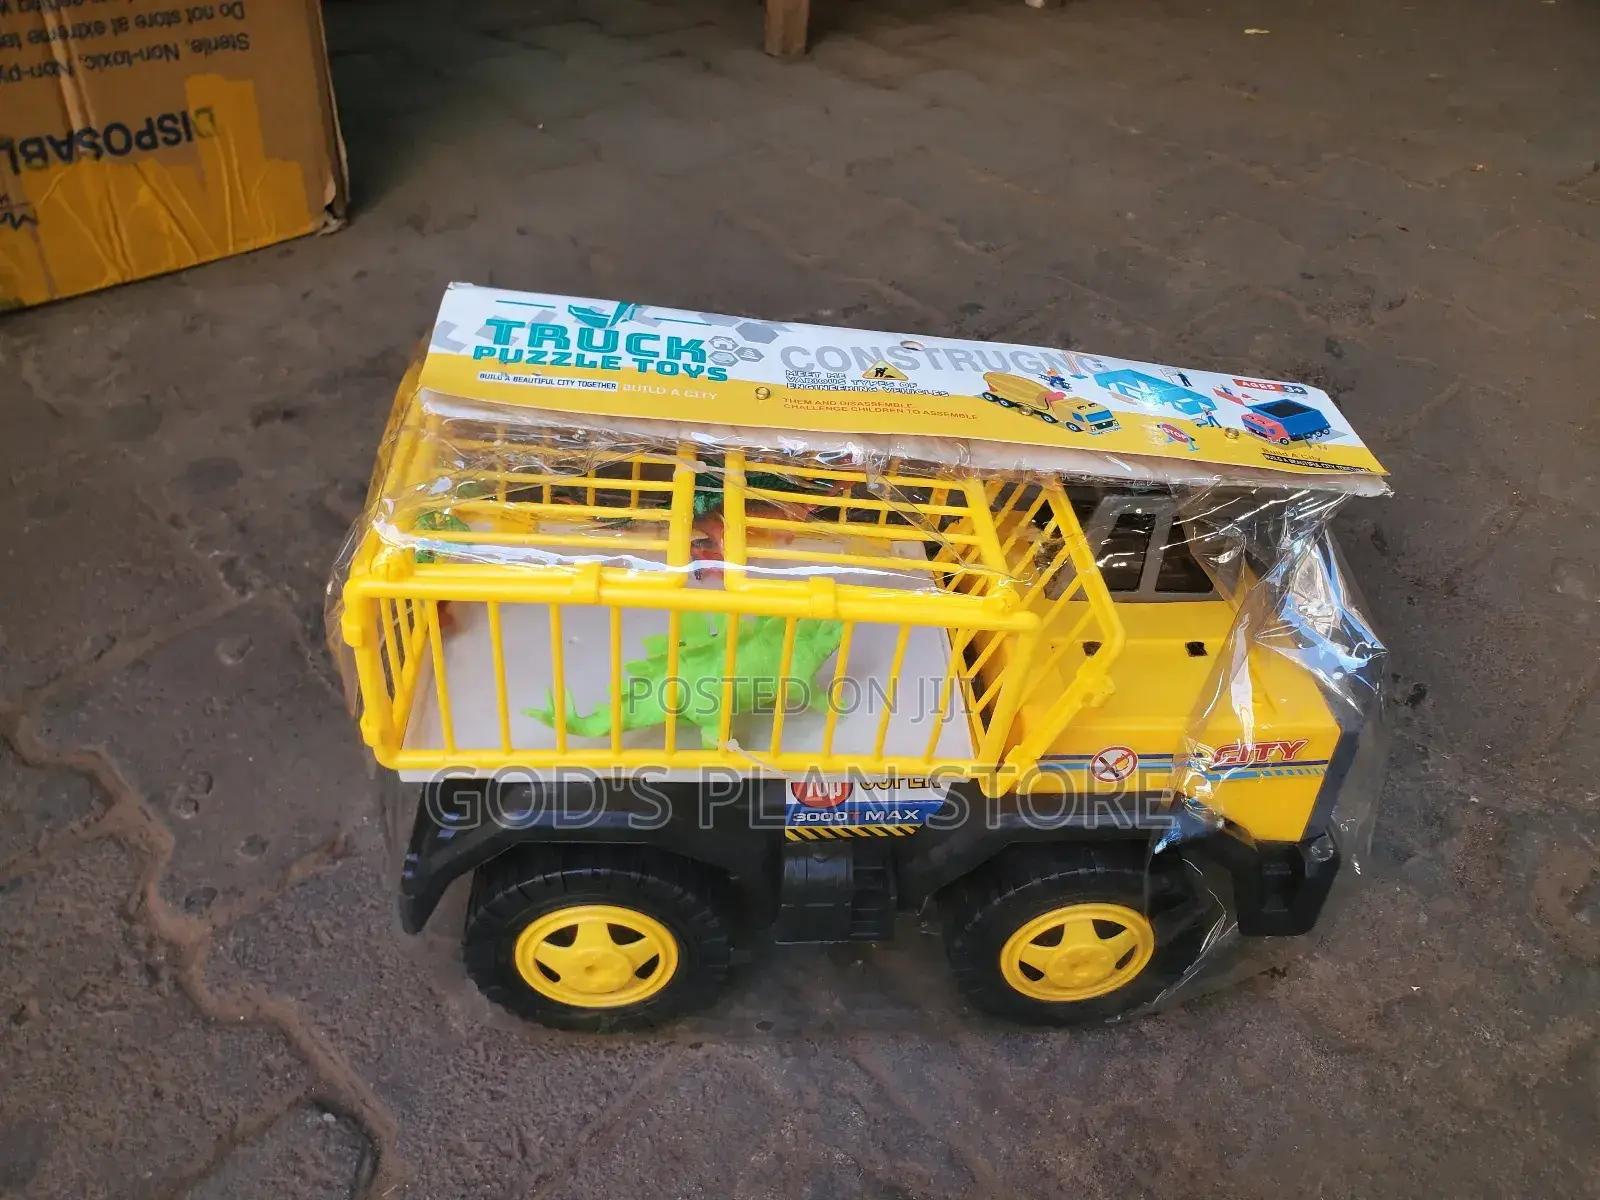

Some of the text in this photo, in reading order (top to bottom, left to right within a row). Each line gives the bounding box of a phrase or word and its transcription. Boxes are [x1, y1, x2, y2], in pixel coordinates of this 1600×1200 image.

[187, 5, 214, 23] not
[219, 2, 245, 20] Do
[111, 17, 130, 36] at
[135, 12, 182, 29] store
[485, 318, 708, 364] TRUCK
[473, 345, 728, 383] PUZZLE TOYS
[785, 370, 822, 379] MEET
[786, 376, 846, 385] VARIOUS
[851, 380, 895, 388] TYPES
[480, 373, 503, 381] BUILD
[513, 376, 555, 386] BEAUTIFUL
[557, 379, 575, 387] CITY
[577, 380, 617, 391] TOGETHER
[622, 384, 666, 395] BUILD
[671, 388, 680, 397] A
[684, 390, 718, 400] CITY
[786, 383, 950, 397] ENGINEERING VEHICLES
[1241, 381, 1303, 394] AGES 3+
[783, 398, 812, 406] THEM
[839, 401, 913, 409] DISASSEMBLE
[783, 404, 848, 412] CHALLENGE
[850, 406, 904, 414] CHILDREN
[922, 410, 979, 420] ASSEMBLE
[1163, 427, 1187, 441] STOP
[1210, 739, 1309, 765] CITY
[793, 809, 919, 822] 3000T MAX
